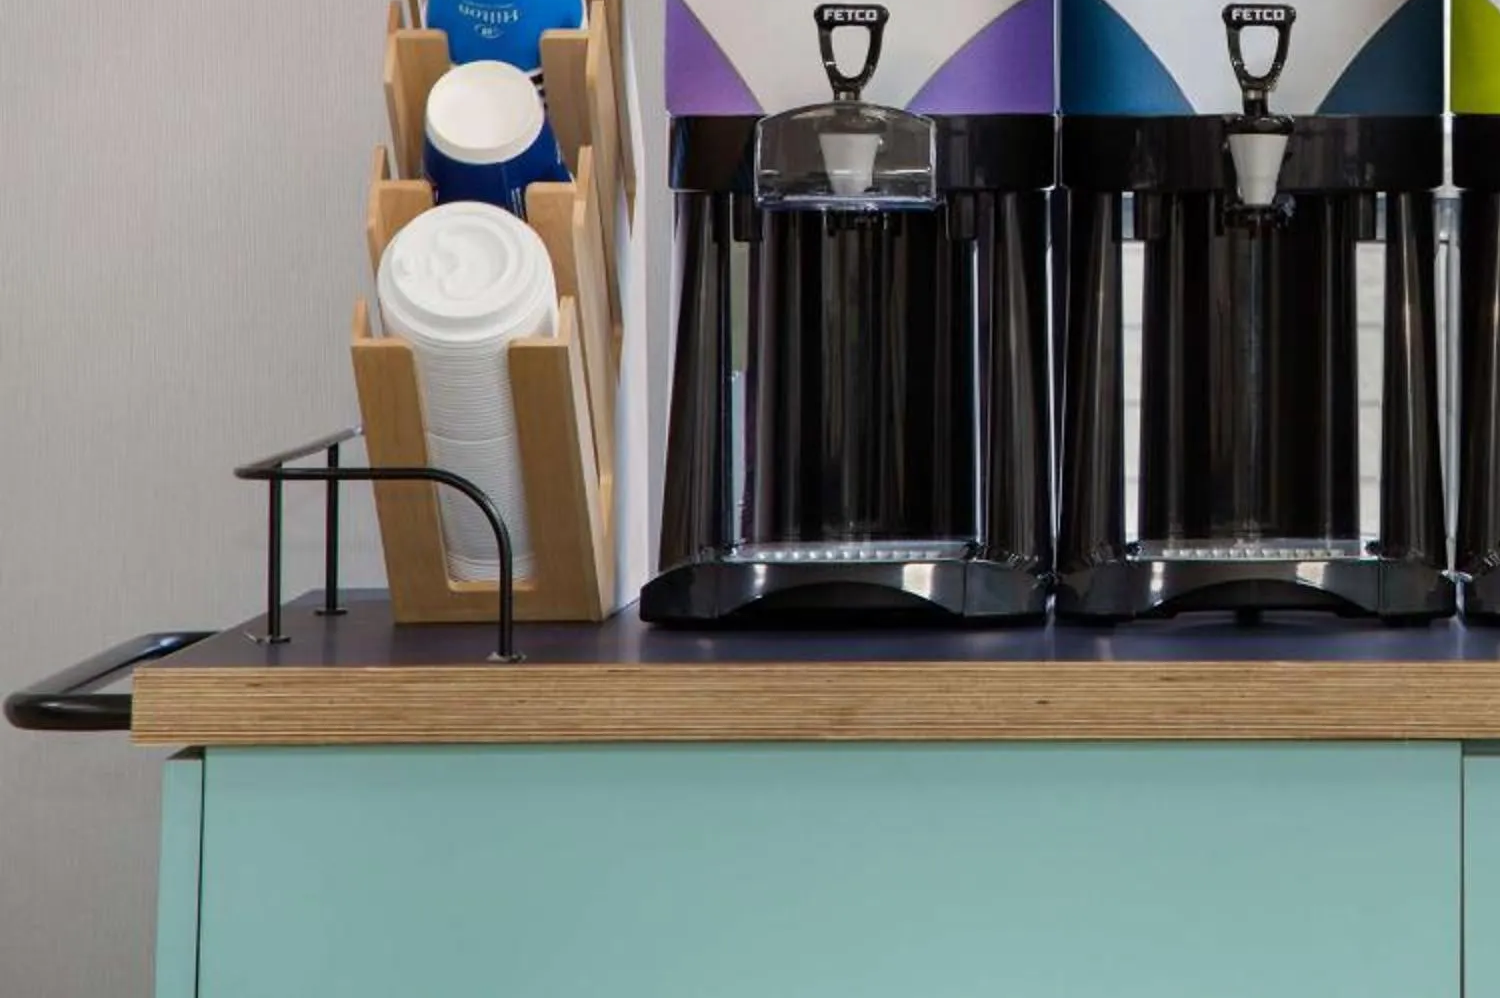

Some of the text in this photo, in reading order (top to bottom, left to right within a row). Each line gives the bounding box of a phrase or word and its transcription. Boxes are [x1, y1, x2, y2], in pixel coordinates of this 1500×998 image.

[458, 3, 519, 23] Hilton
[823, 8, 877, 21] FETCO
[1231, 8, 1285, 21] FETCO
